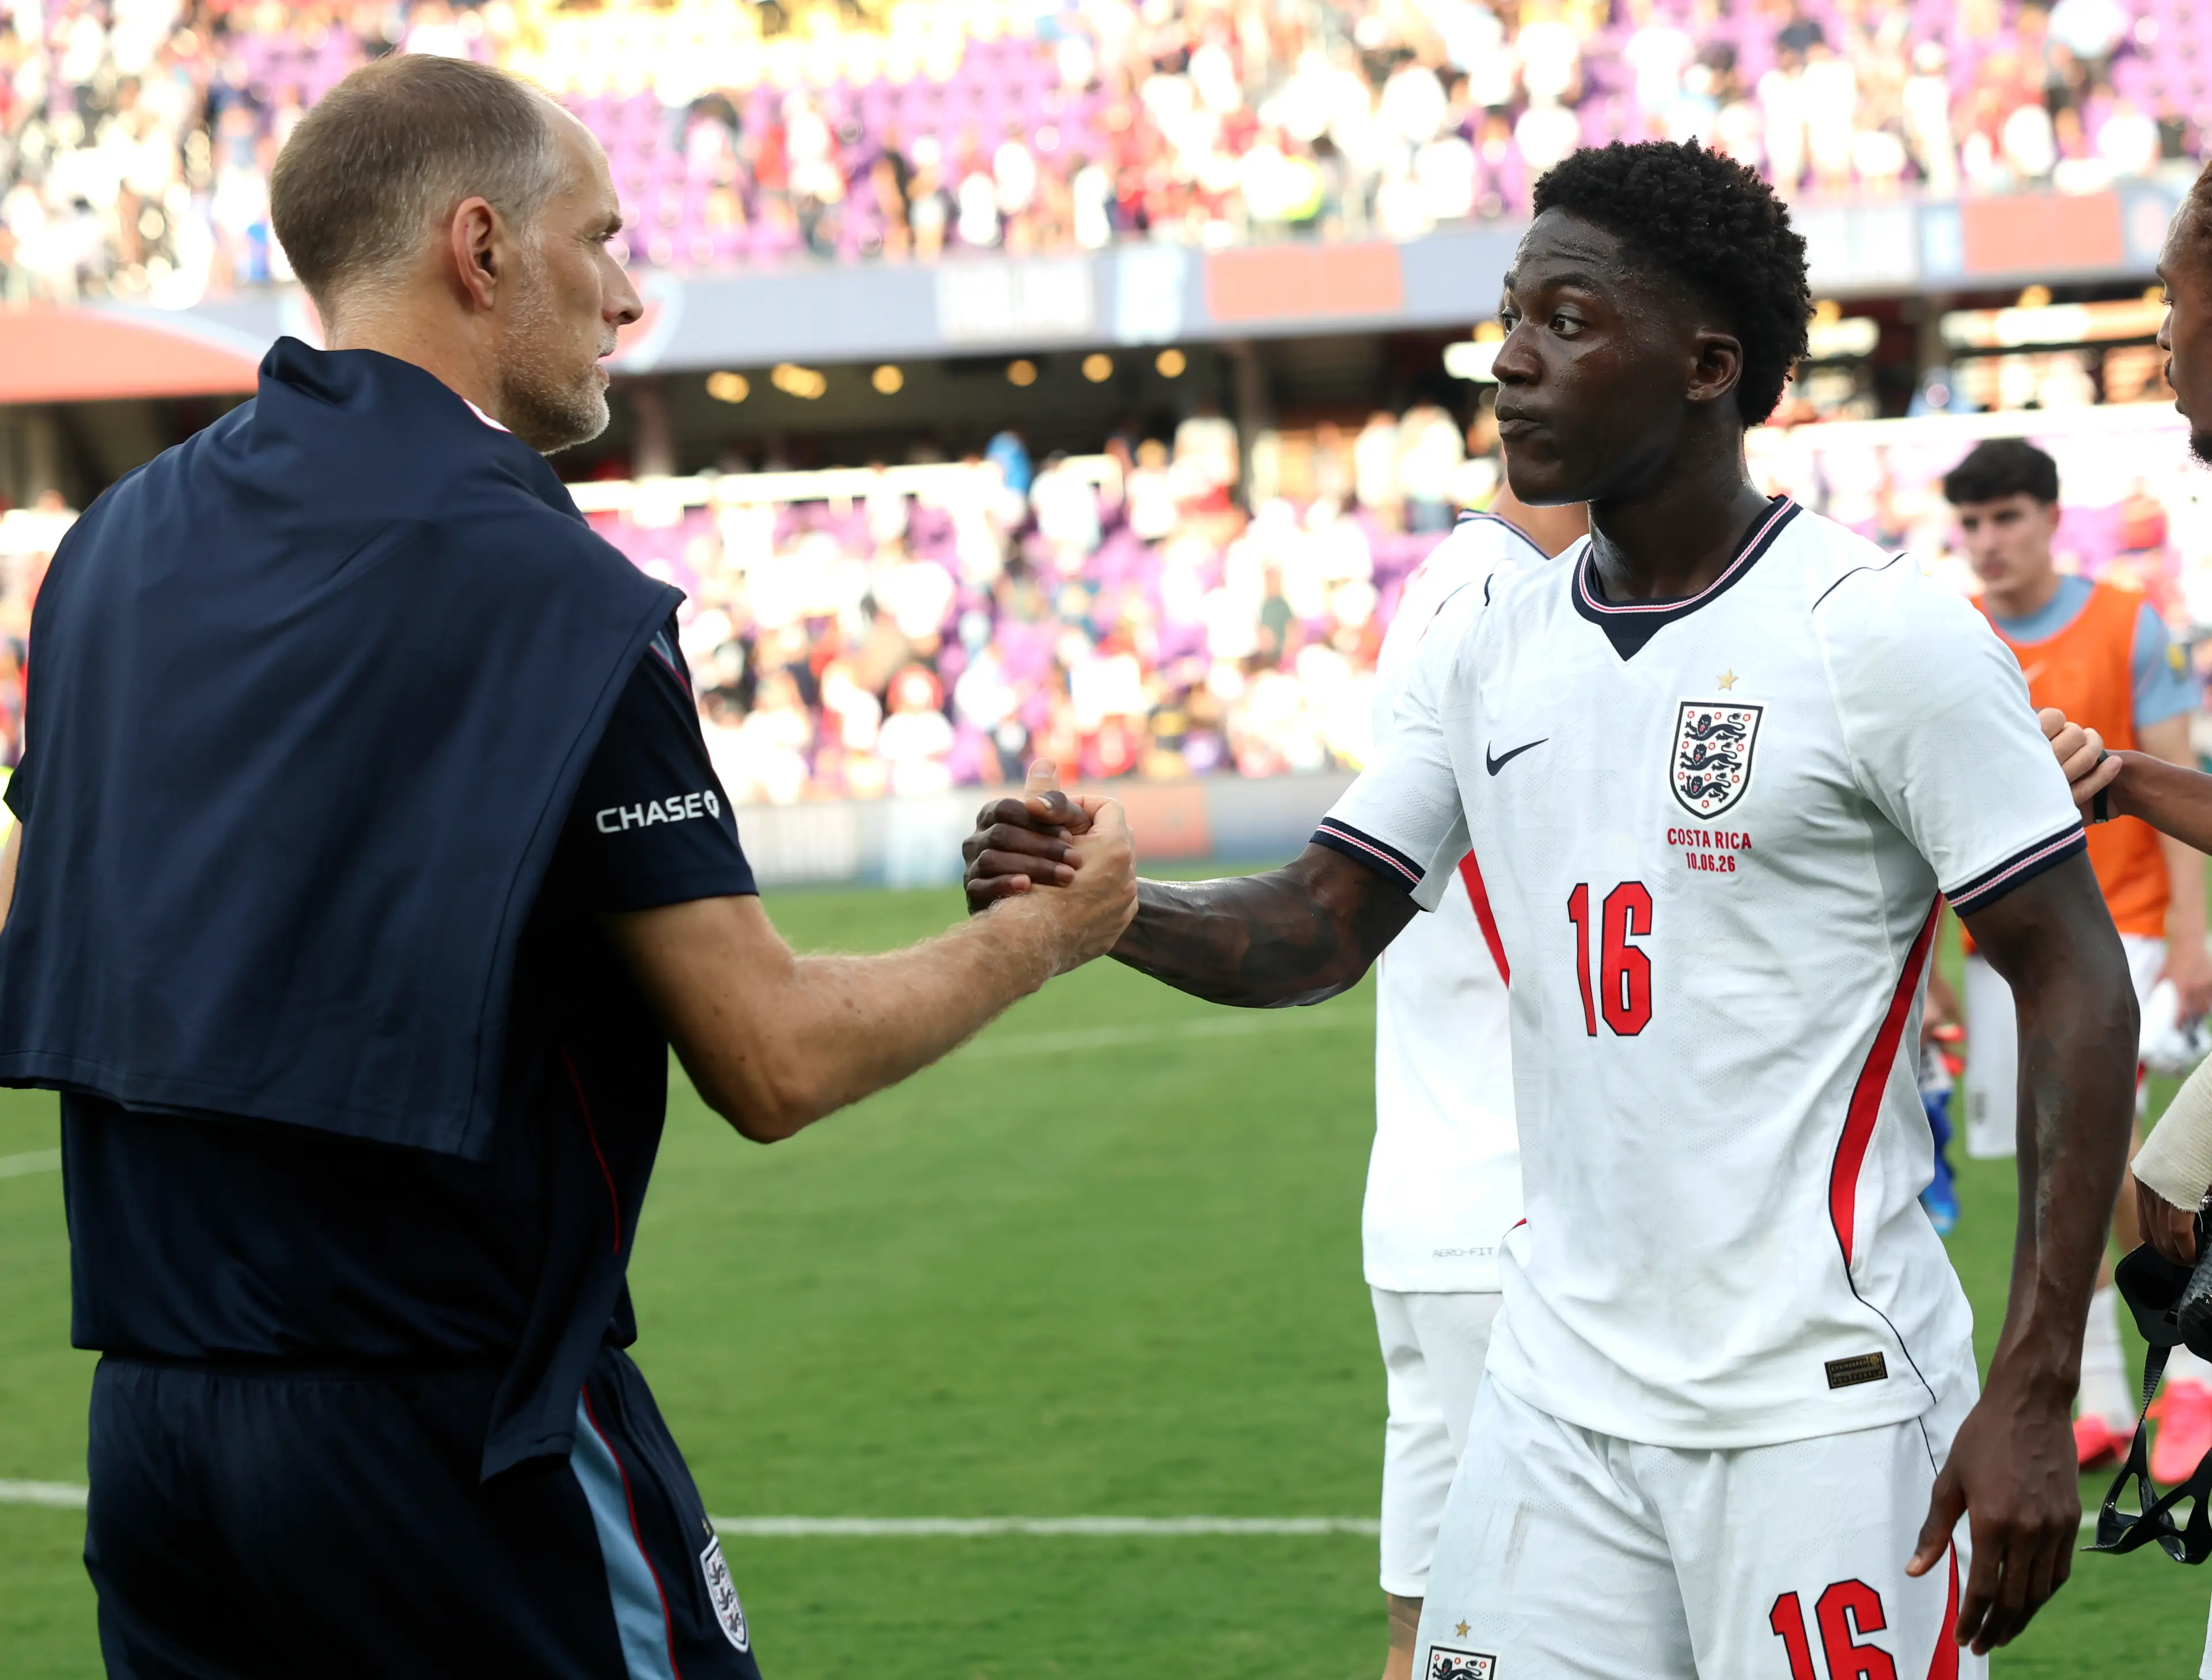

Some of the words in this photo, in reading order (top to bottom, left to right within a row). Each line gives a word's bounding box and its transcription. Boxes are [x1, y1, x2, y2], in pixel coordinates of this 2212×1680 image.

[596, 792, 704, 834] CHASE
[1667, 828, 1711, 847] COSTA
[1715, 831, 1752, 850] RICA
[1685, 852, 1736, 873] 10.06.26
[1567, 881, 1653, 1037] 16
[1432, 1247, 1494, 1258] AERO-FIT
[1768, 1578, 1898, 1680] 16
